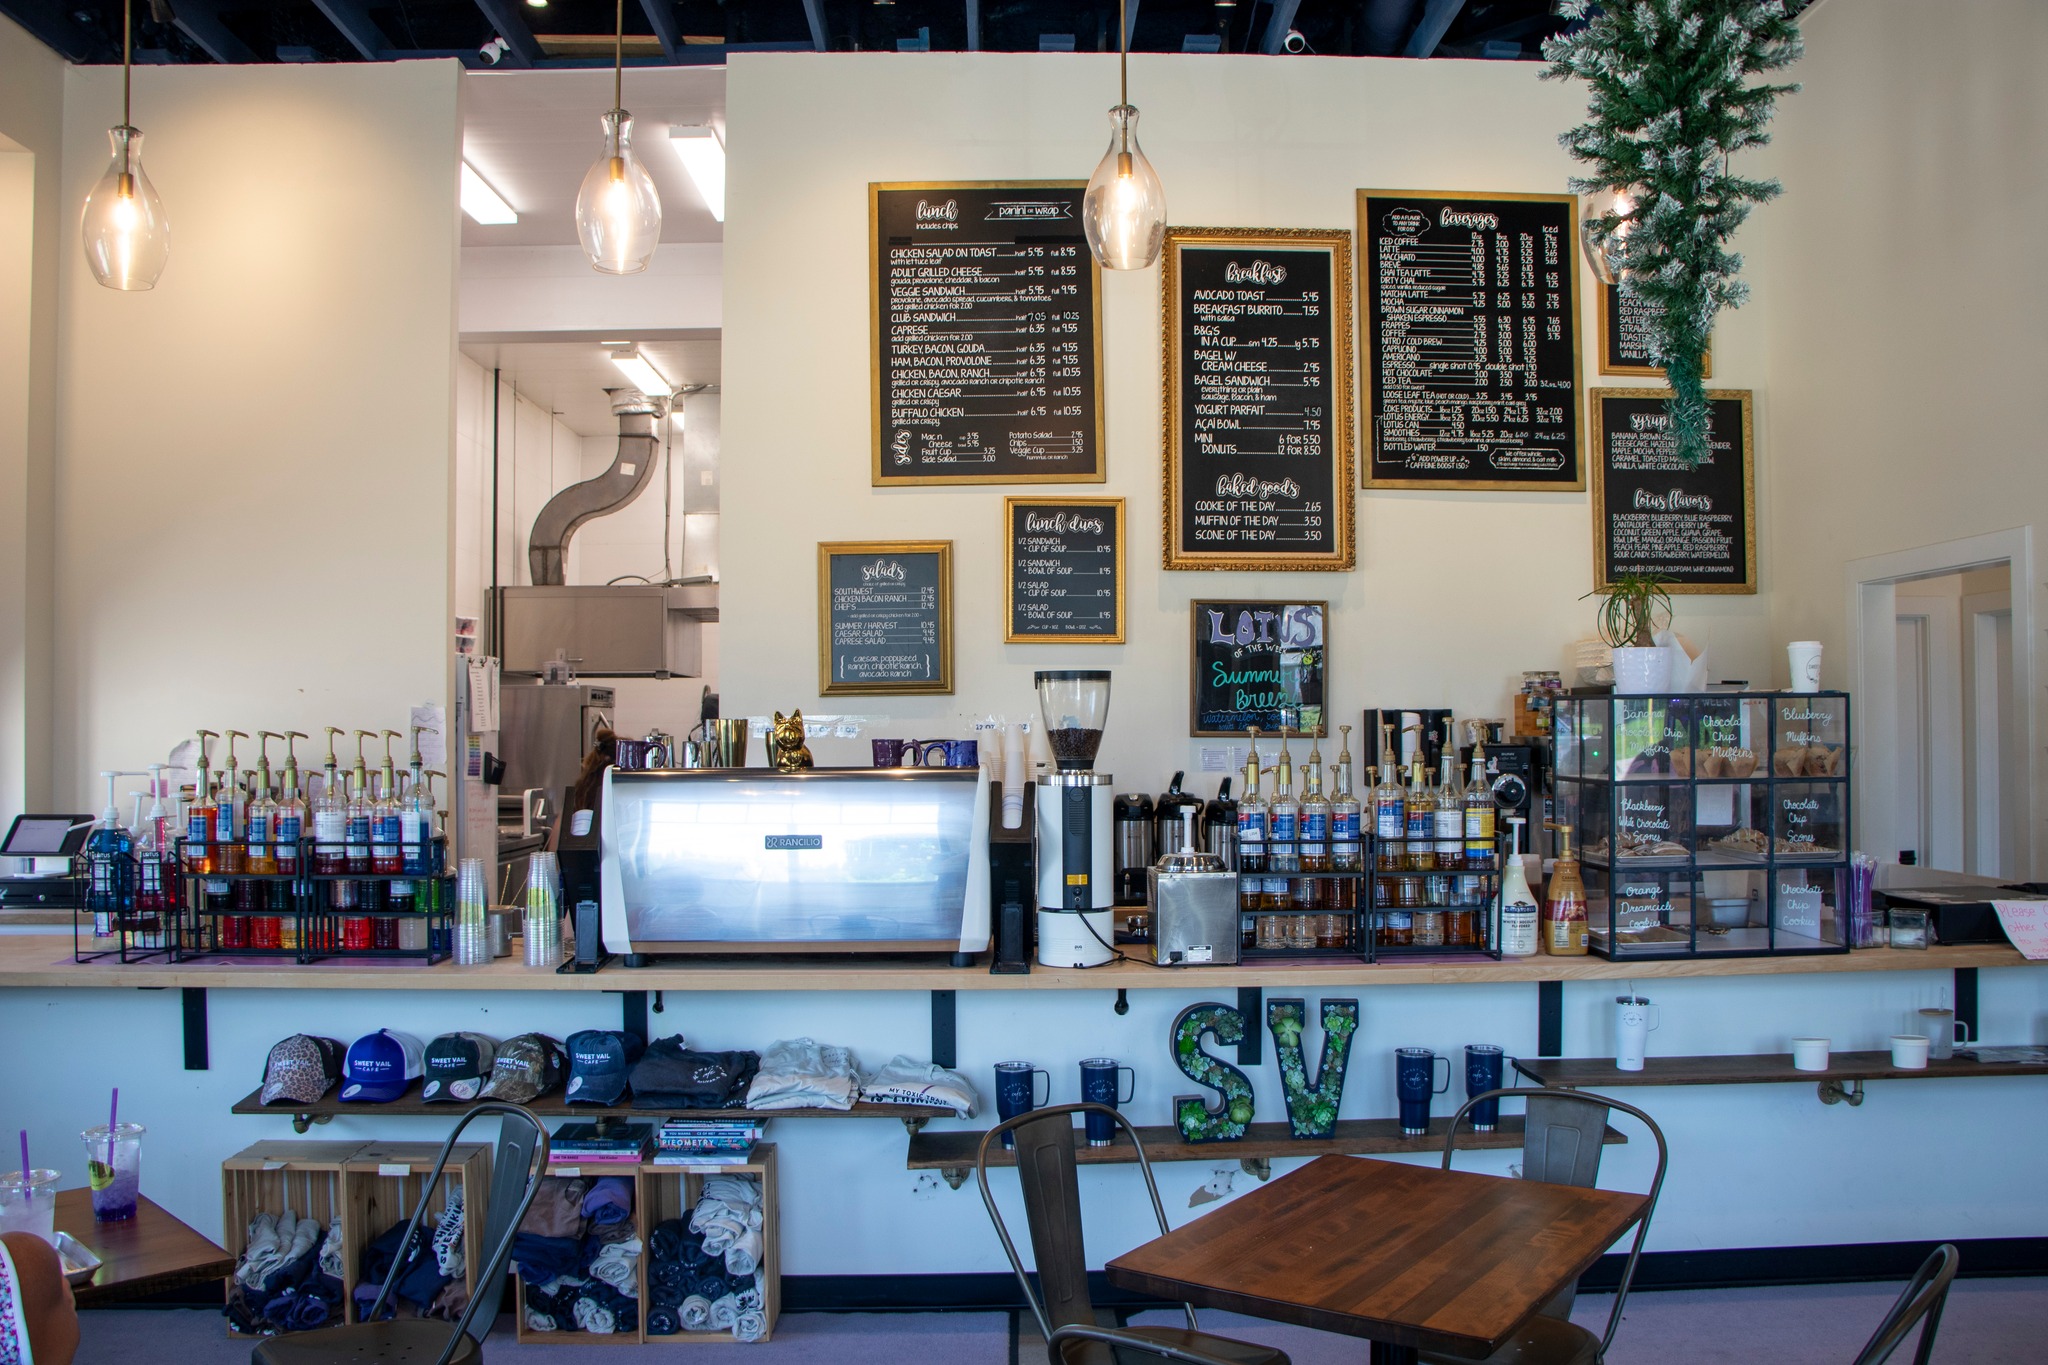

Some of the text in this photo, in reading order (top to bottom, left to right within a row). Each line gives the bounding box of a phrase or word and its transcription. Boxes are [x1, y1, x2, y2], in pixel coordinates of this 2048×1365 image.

[917, 200, 957, 220] lunch
[999, 206, 1026, 216] panini
[942, 222, 958, 230] chips
[891, 247, 1076, 258] CHICKEN SALAD ON TOAST 5.95 8.95
[1380, 245, 1400, 253] LATTE
[1380, 253, 1415, 261] MACCHIATO
[891, 266, 1076, 277] ADULT GRILLED CHEESE 5.95 8.55
[891, 285, 1077, 296] VEGGIE SANDWICH 5.95 9.95
[1194, 291, 1234, 300] AVOCADO
[1236, 290, 1265, 300] TOAST
[1194, 304, 1319, 315] BREAKFAST BURRITO 7.55
[891, 313, 911, 322] CLUB
[913, 312, 956, 321] SANDWICH
[891, 323, 1077, 335] CAPRESE 6.35 9.55
[1201, 337, 1319, 348] IN A CUP 4.25 5.75
[957, 344, 985, 353] GOUDA
[946, 356, 991, 365] PROVOLONE
[1194, 350, 1222, 360] BAGEL
[1382, 353, 1420, 361] AMERICANO
[961, 368, 990, 377] RANCH
[1202, 362, 1319, 372] CREAM CHEESE 2.95
[1382, 369, 1432, 377] HOT CHOCOLATE
[1194, 375, 1320, 386] BAGEL SANDWICH 5.95
[892, 407, 964, 418] BUFFALO CHICKEN
[1195, 405, 1321, 416] YOGURT PARFAIT 4.50
[1405, 413, 1430, 421] ENERGY
[1217, 419, 1241, 429] BOWL
[1303, 420, 1320, 430] 7.95
[1009, 431, 1031, 439] Potato
[1195, 433, 1320, 444] MINI 6 5.50
[1202, 444, 1320, 455] DONUTS 12 8.50
[1260, 478, 1299, 499] goods
[1635, 489, 1666, 509] lotus
[1195, 501, 1321, 511] COOKIE OF THE DAY 2.65
[1027, 513, 1101, 532] lunch duos
[1195, 515, 1321, 525] MUFFIN 3.50
[1195, 530, 1321, 540] SCONE 3.50
[1208, 607, 1316, 647] LOTUS
[1234, 648, 1242, 658] OF
[1246, 644, 1262, 653] THE
[1782, 708, 1832, 726] Blueberry
[1664, 728, 1683, 740] Chip
[902, 1090, 923, 1098] TOXIC
